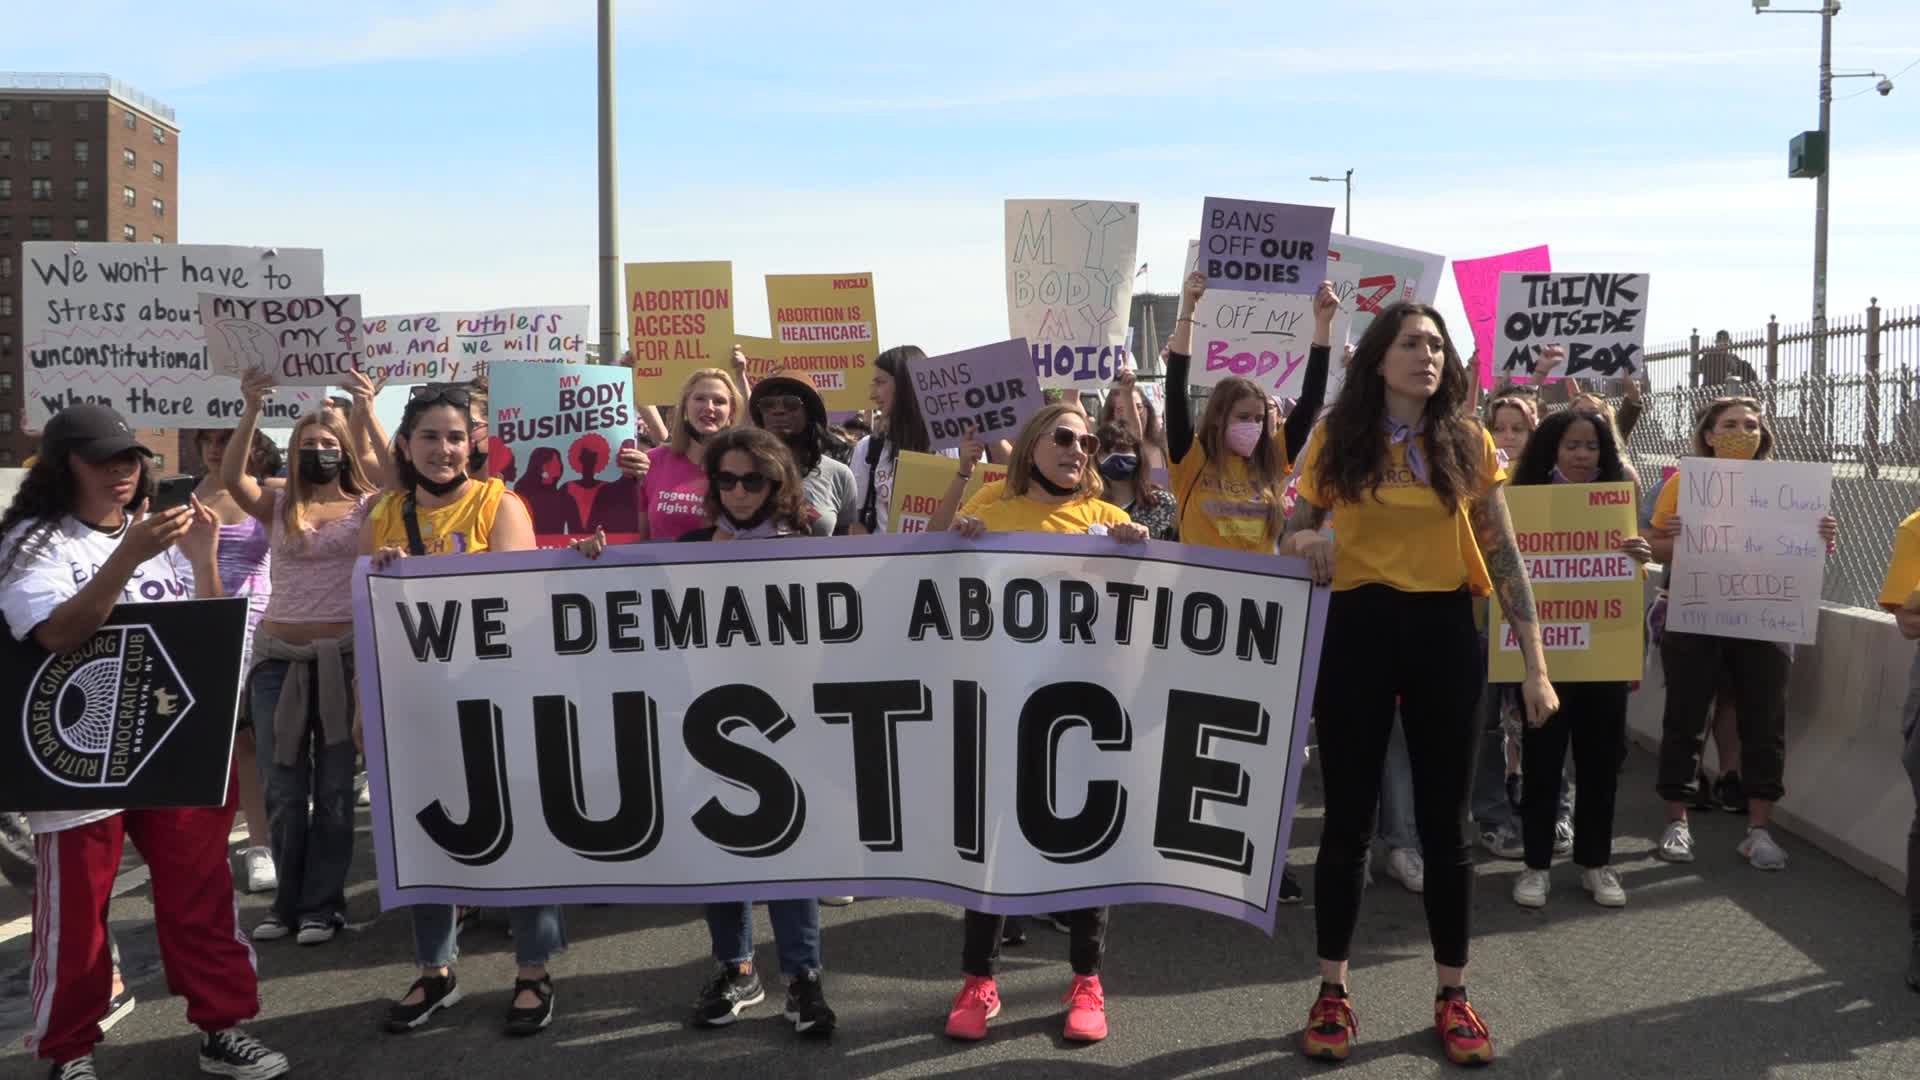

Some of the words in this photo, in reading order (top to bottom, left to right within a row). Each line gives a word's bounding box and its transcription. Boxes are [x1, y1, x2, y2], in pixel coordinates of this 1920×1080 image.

[1211, 208, 1276, 234] BANS
[1012, 201, 1126, 271] MY
[1208, 234, 1256, 256] OFF
[1260, 238, 1315, 262] OUR
[32, 254, 88, 286] We
[99, 256, 168, 285] won't
[181, 256, 248, 288] have
[264, 265, 291, 290] to
[833, 278, 868, 290] NYCLU
[1207, 259, 1300, 284] BODIES
[633, 289, 729, 312] ABORTION
[1014, 269, 1125, 308] BODY
[1521, 273, 1639, 308] THINK
[213, 298, 256, 319] MY
[263, 296, 350, 326] BODY
[398, 316, 440, 333] are
[456, 313, 562, 334] ruthless
[634, 313, 705, 336] ACCESS
[777, 307, 843, 322] ABORTION
[848, 306, 861, 320] IS
[1216, 304, 1257, 329] OFF
[1265, 309, 1303, 331] MY
[1504, 308, 1641, 341] OUTSIDE
[280, 327, 328, 349] MY
[782, 325, 871, 341] HEALTHCARE.
[1038, 304, 1119, 346] MY
[31, 344, 208, 371] unconstitutional
[366, 341, 400, 357] ow.
[406, 337, 449, 354] And
[462, 340, 492, 354] we
[504, 335, 540, 352] will
[548, 334, 584, 352] act
[636, 341, 669, 361] FOR
[674, 338, 710, 360] ALL.
[366, 357, 467, 381] cordingly.
[638, 368, 662, 377] ACLU
[783, 355, 848, 371] ABORTION
[851, 353, 865, 368] IS
[1032, 343, 1125, 381] HOICE
[1565, 343, 1640, 376] BOX
[560, 375, 581, 388] MY
[916, 363, 972, 392] BANS
[128, 387, 194, 415] there
[207, 397, 245, 419] are
[559, 382, 625, 412] BODY
[924, 392, 959, 416] OFF
[965, 378, 1027, 405] OUR
[498, 407, 521, 421] MY
[498, 404, 629, 444] BUSINESS
[1589, 491, 1631, 506] NYCLU
[1689, 471, 1744, 508] NOT
[1747, 493, 1769, 509] the
[1517, 530, 1599, 552] BORTION
[1605, 529, 1622, 549] IS
[1686, 524, 1735, 553] NOT
[1526, 556, 1633, 578] EALTHCARE.
[1682, 572, 1709, 598] I
[1718, 573, 1800, 598] DECIDE
[396, 597, 512, 662] WE
[551, 581, 864, 656] DEMAND
[908, 578, 1284, 665] ABORTION
[1604, 599, 1622, 619] IS
[1543, 626, 1585, 647] GHT.
[40, 636, 117, 695] GINSBURG
[111, 676, 141, 777] DEMOCRATIC
[126, 633, 145, 673] CLUB
[32, 702, 60, 758] BADER
[54, 752, 99, 777] RUTH
[414, 678, 1270, 875] JUSTICE
